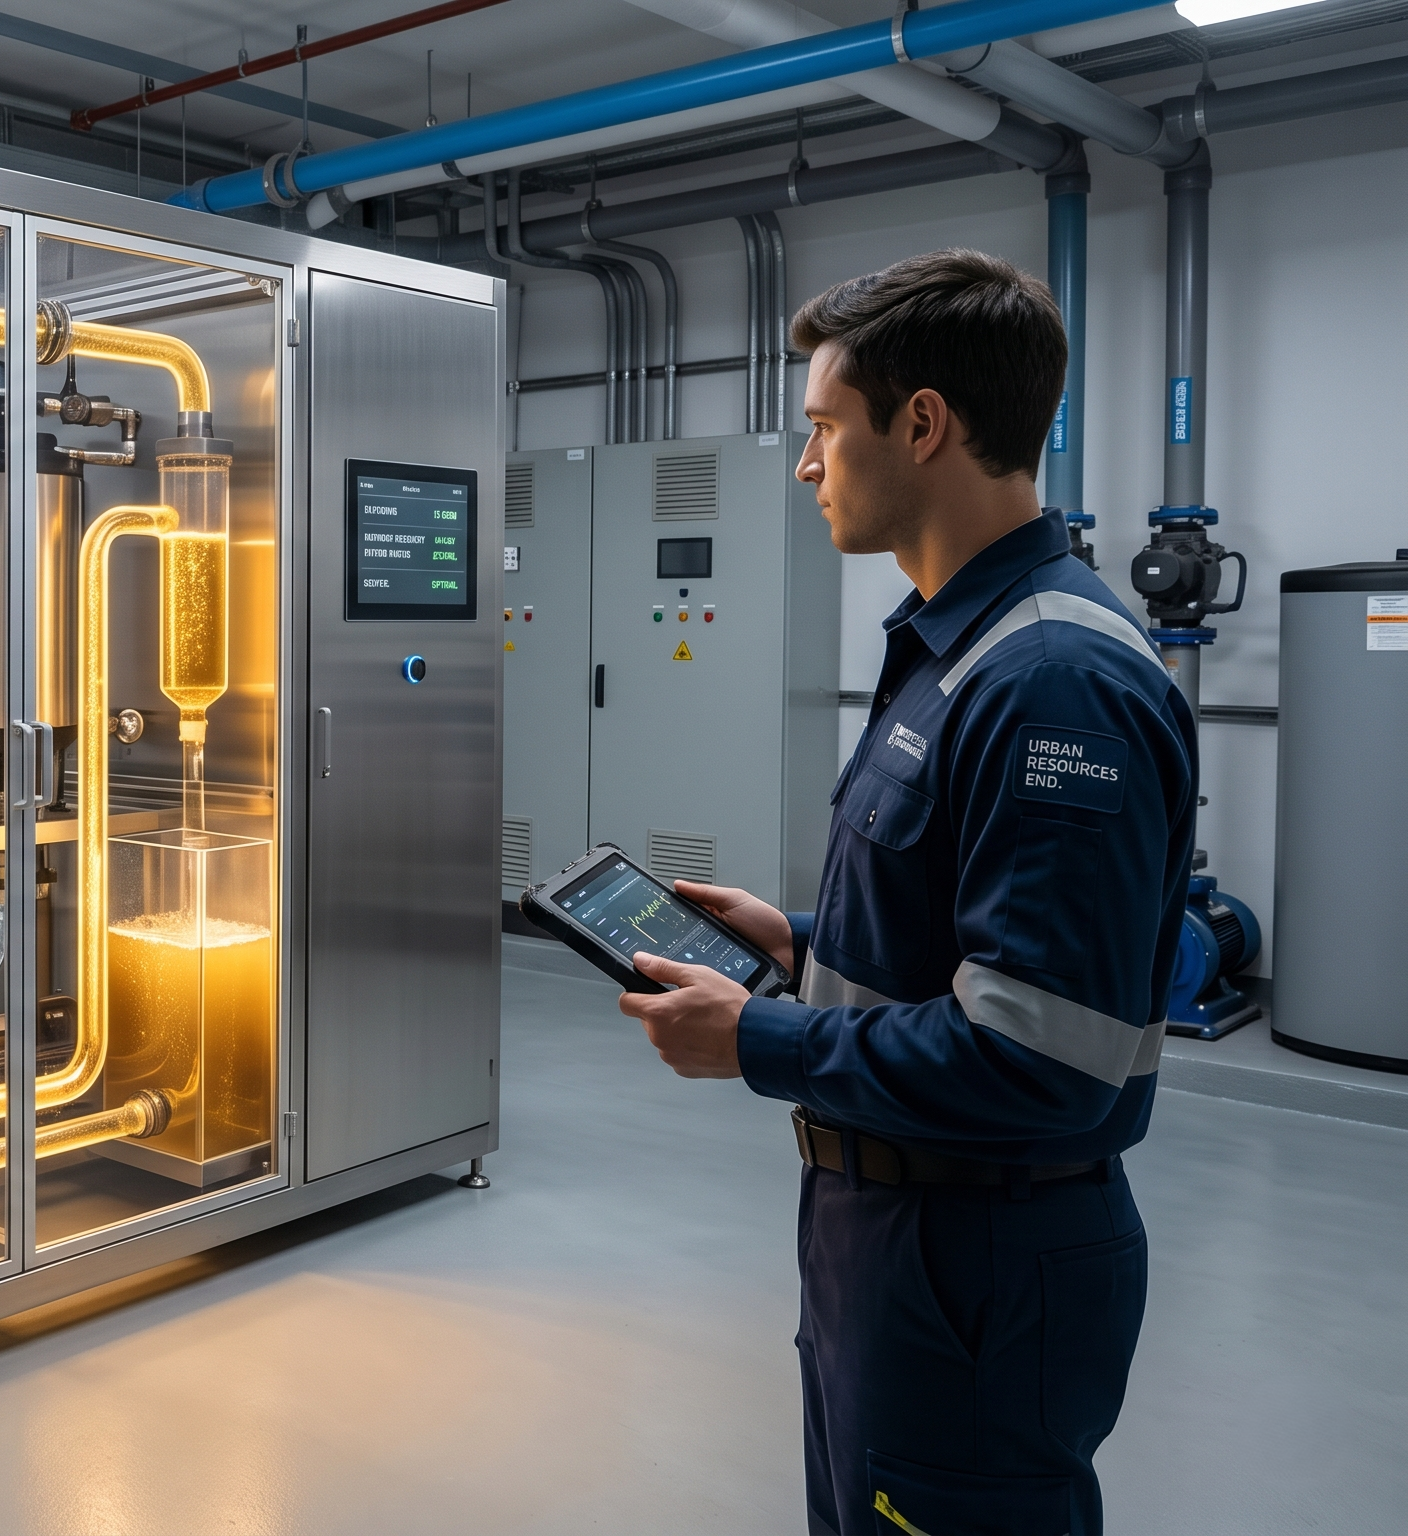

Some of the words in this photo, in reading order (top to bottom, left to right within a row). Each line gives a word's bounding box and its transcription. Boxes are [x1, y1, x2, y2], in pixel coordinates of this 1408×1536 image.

[1028, 739, 1083, 758] URBAN
[1026, 756, 1119, 781] RESOURCES
[1025, 773, 1063, 789] END.
